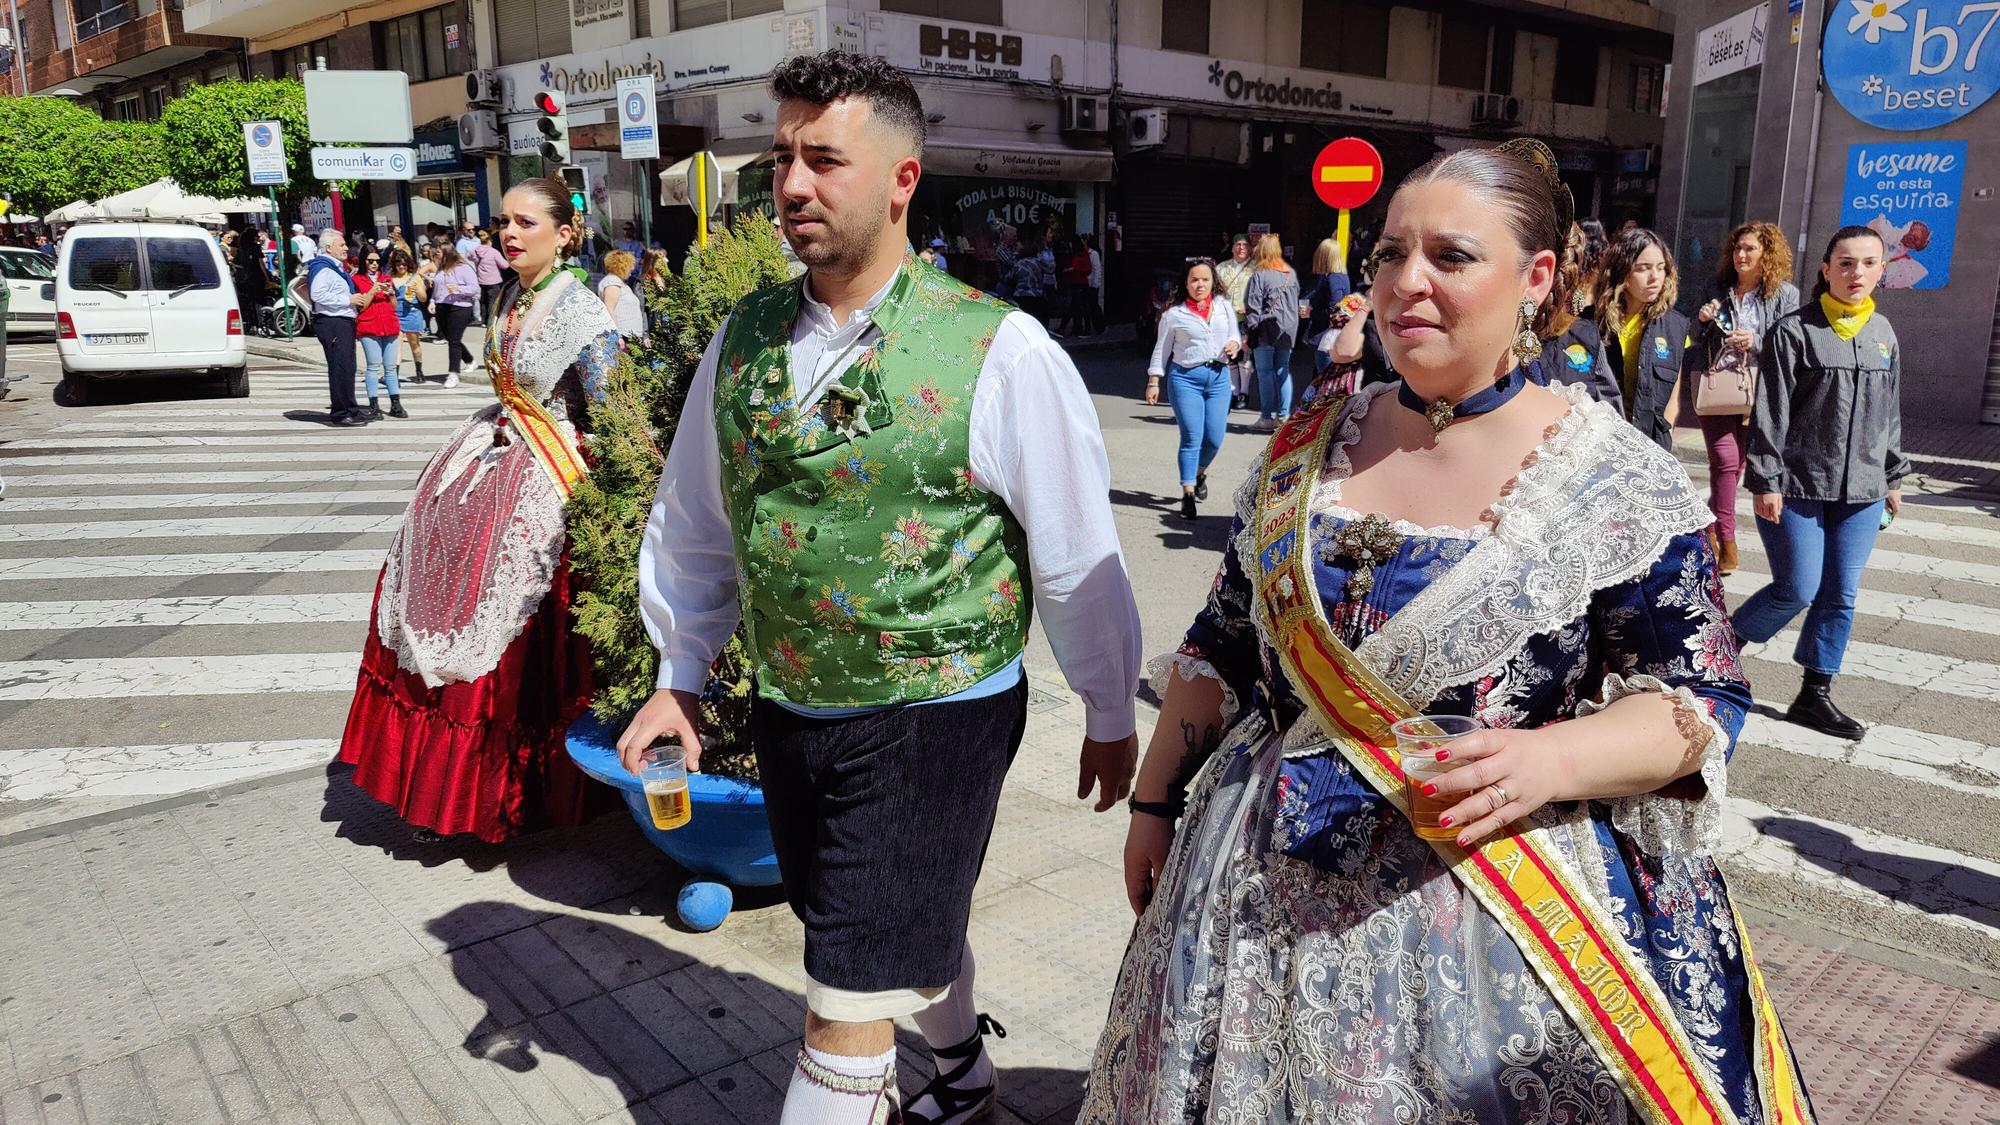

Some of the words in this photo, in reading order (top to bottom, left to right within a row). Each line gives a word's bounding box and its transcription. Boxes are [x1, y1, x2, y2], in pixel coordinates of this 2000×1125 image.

[1909, 2, 2000, 76] b7
[1709, 40, 1744, 66] beset.es
[920, 58, 932, 69] Un
[975, 64, 991, 75] Una
[1224, 70, 1343, 110] Ortodoncia
[1883, 83, 1971, 110] beset
[317, 152, 384, 167] comuniKar
[1002, 155, 1036, 166] Yolanda
[1038, 157, 1061, 167] Gracia
[1858, 150, 1957, 178] besame
[1876, 180, 1895, 190] en
[1899, 178, 1932, 189] esta
[955, 189, 987, 212] TODA
[990, 187, 1004, 198] LA
[986, 208, 996, 222] A
[92, 336, 118, 344] 3751
[125, 335, 145, 343] DGN
[1263, 507, 1297, 538] 2023
[1527, 898, 1647, 1045] MAJOR
